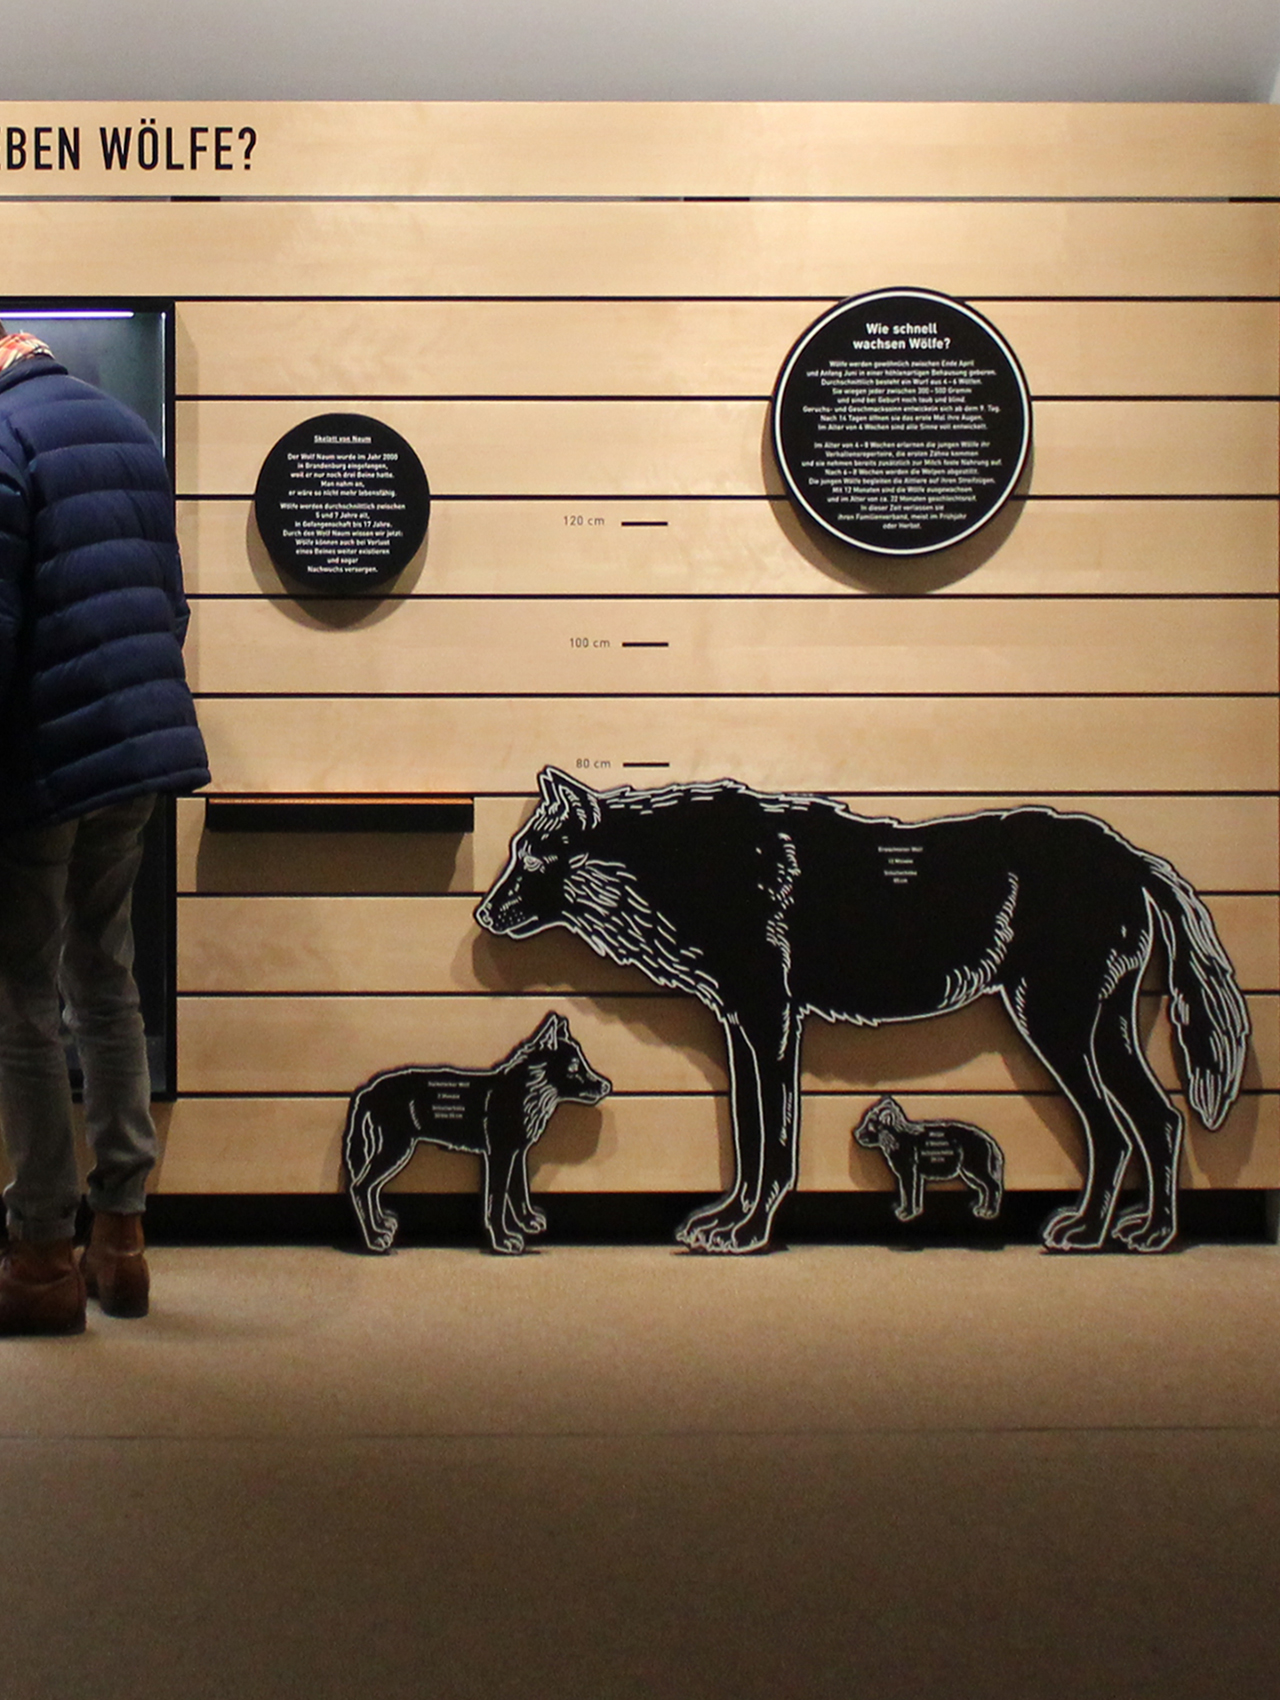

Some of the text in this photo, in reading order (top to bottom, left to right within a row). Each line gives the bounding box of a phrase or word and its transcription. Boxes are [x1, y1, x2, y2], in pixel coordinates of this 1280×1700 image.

[100, 118, 258, 170] WÖLFE?
[866, 323, 937, 334] Wie schnell
[853, 338, 950, 349] wachsen Wölfe?
[563, 516, 605, 526] 120 cm
[569, 638, 610, 648] 100 cm
[576, 758, 611, 769] 80 cm
